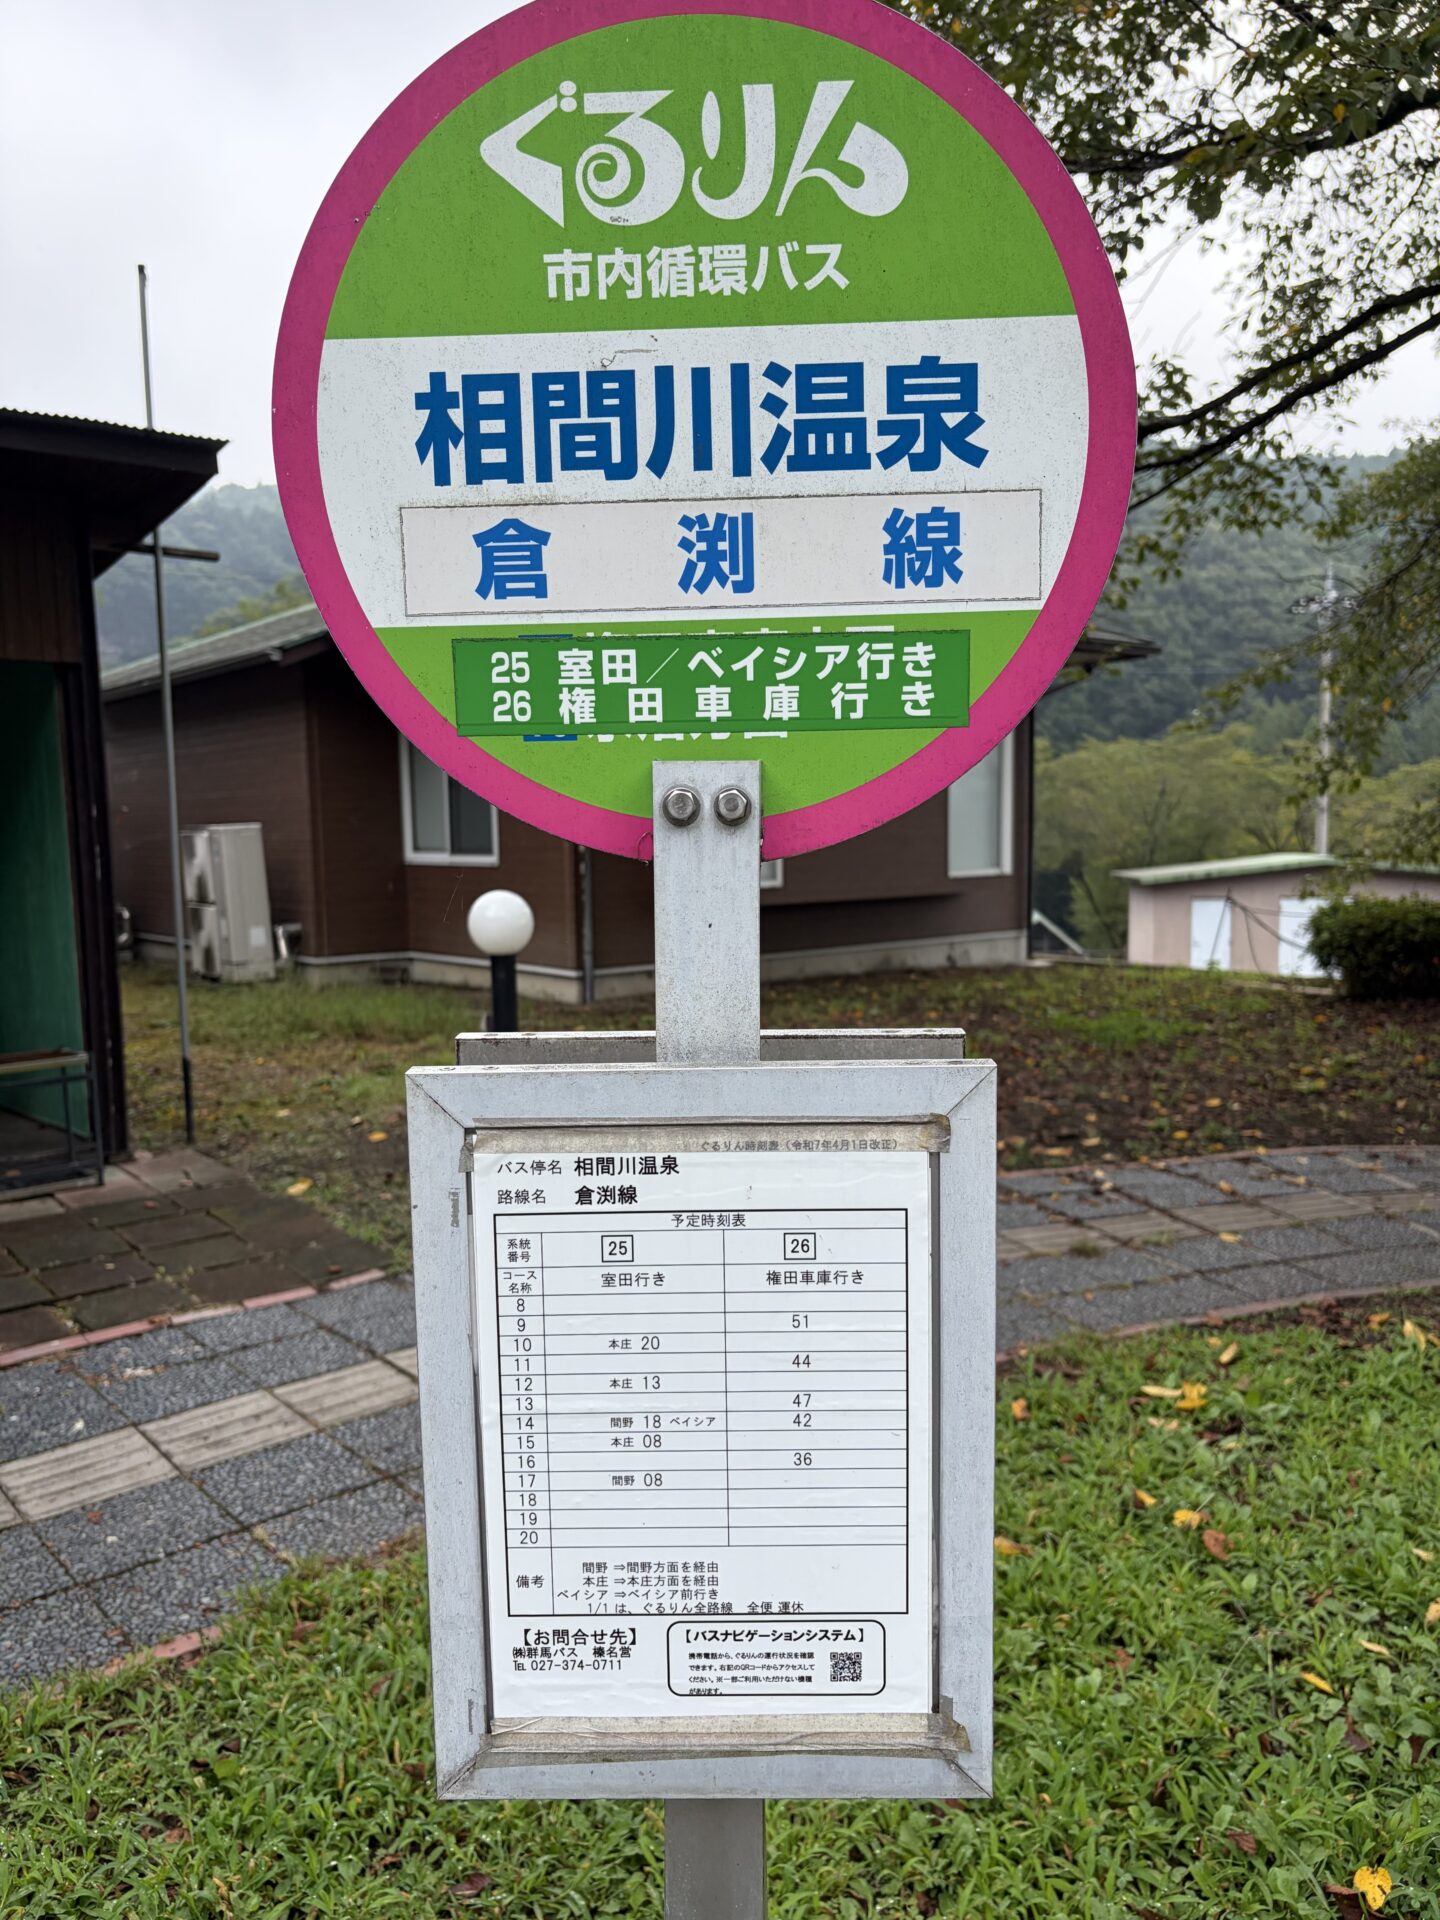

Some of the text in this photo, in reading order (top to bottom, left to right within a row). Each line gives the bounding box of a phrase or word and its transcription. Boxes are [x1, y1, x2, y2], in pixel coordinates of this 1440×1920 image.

[479, 79, 910, 229] ぐるりん
[542, 242, 851, 302] 市内循環バス
[414, 355, 990, 487] 相間川温泉
[472, 506, 965, 602] 倉渕線
[490, 648, 530, 685] 25
[492, 681, 937, 726] 26 権田車庫行き
[497, 1155, 680, 1177] バス停名 相間川温泉
[497, 1184, 638, 1206] 路線名 倉渕線
[671, 1213, 746, 1228] 予定時刻表
[507, 1238, 531, 1250] 系統
[608, 1241, 627, 1256] 25
[791, 1238, 810, 1253] 26
[507, 1251, 531, 1263] 番号
[503, 1271, 537, 1280] コース
[601, 1272, 665, 1287] 室田行き
[766, 1269, 864, 1286] 権田車庫行き
[508, 1282, 532, 1294] 名称
[517, 1298, 525, 1312] 8
[517, 1318, 525, 1332] 9
[792, 1314, 808, 1328] 51
[514, 1338, 531, 1352] 10
[608, 1336, 660, 1350] 本庄 20
[515, 1358, 529, 1371] 11
[792, 1354, 811, 1368] 44
[515, 1377, 532, 1391] 12
[609, 1375, 660, 1390] 本庄 13
[516, 1397, 533, 1411] 13
[793, 1393, 811, 1407] 47
[517, 1416, 534, 1430] 14
[611, 1415, 715, 1429] 間野 18 ベイシア
[793, 1413, 811, 1427] 42
[517, 1435, 535, 1449] 15
[611, 1434, 662, 1448] 本庄 08
[518, 1455, 535, 1469] 16
[794, 1452, 812, 1466] 36
[519, 1474, 535, 1488] 17
[612, 1473, 662, 1487] 間野 08
[520, 1493, 536, 1507] 18
[520, 1512, 537, 1526] 19
[520, 1531, 538, 1544] 20
[582, 1561, 718, 1574] 間野 間野方面を経由
[516, 1575, 544, 1588] 備考
[583, 1575, 718, 1587] 本庄 本庄方面を経由
[557, 1588, 718, 1600] ベイシア ベイシア前行き
[587, 1602, 609, 1614] 1/1
[746, 1601, 774, 1613] 全便
[778, 1601, 805, 1613] 運休
[523, 1627, 637, 1647] 【お問合せ先】
[686, 1628, 864, 1643] 【バスナビゲーションシステム】
[592, 1645, 632, 1658] 榛名営
[531, 1659, 621, 1671] 027-374-0711
